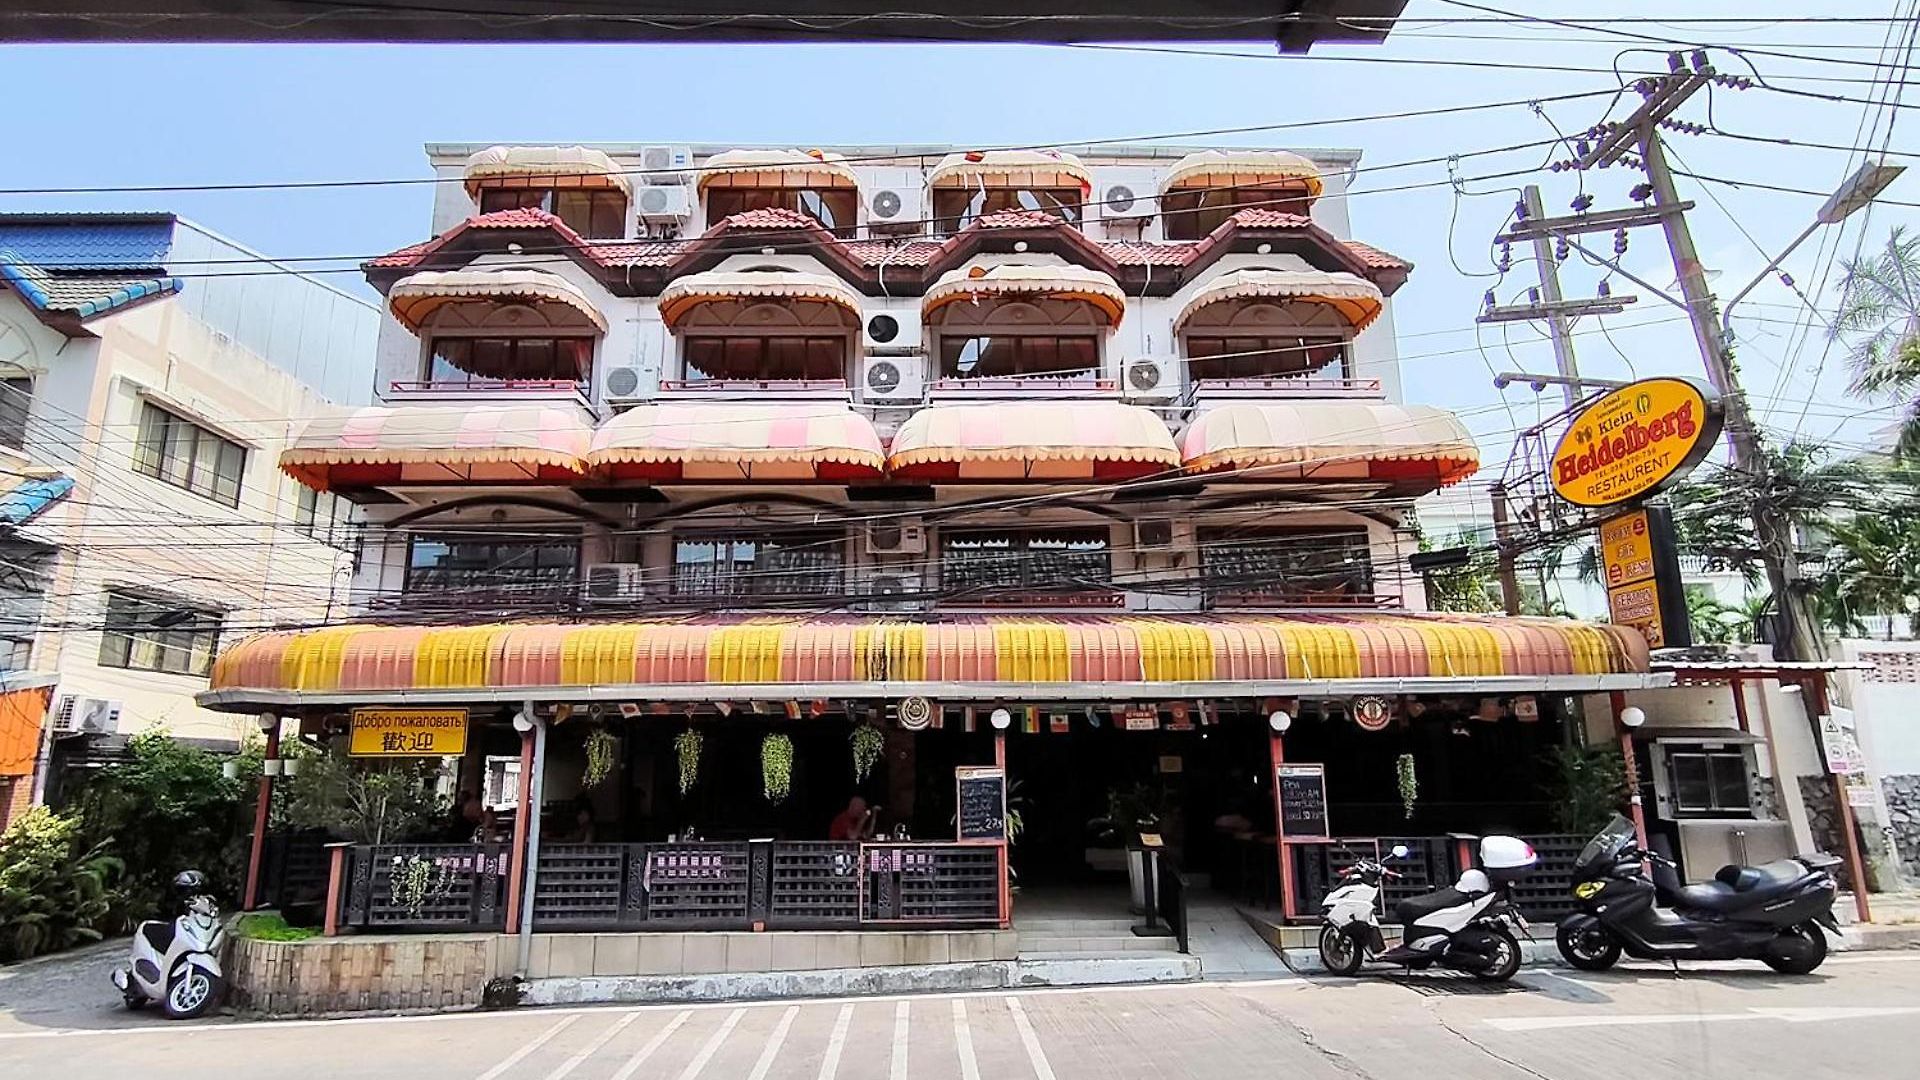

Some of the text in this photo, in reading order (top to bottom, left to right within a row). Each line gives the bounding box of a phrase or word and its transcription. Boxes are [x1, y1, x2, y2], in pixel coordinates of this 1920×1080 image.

[1599, 411, 1634, 435] Klein
[1556, 399, 1697, 485] Heidelberg
[1587, 452, 1671, 498] RESTAURENT
[354, 713, 392, 731] Добро
[382, 731, 434, 751] 歡迎
